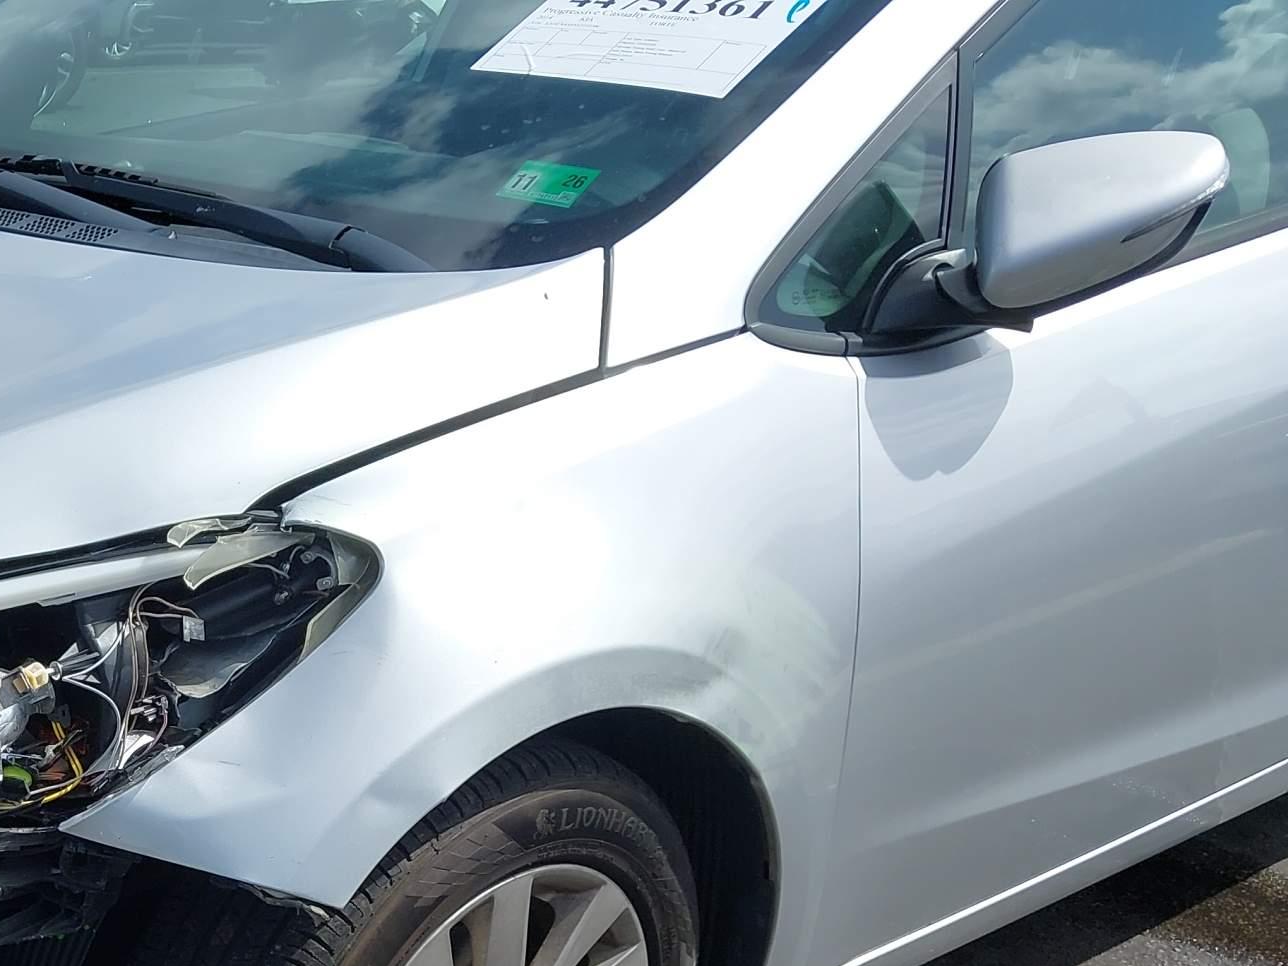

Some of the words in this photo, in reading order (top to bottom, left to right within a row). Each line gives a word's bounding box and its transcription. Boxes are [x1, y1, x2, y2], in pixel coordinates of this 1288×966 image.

[543, 8, 600, 16] Progressive
[601, 10, 644, 18] Casualty
[648, 13, 698, 21] Insurance
[512, 173, 538, 190] 11
[562, 174, 588, 189] 26
